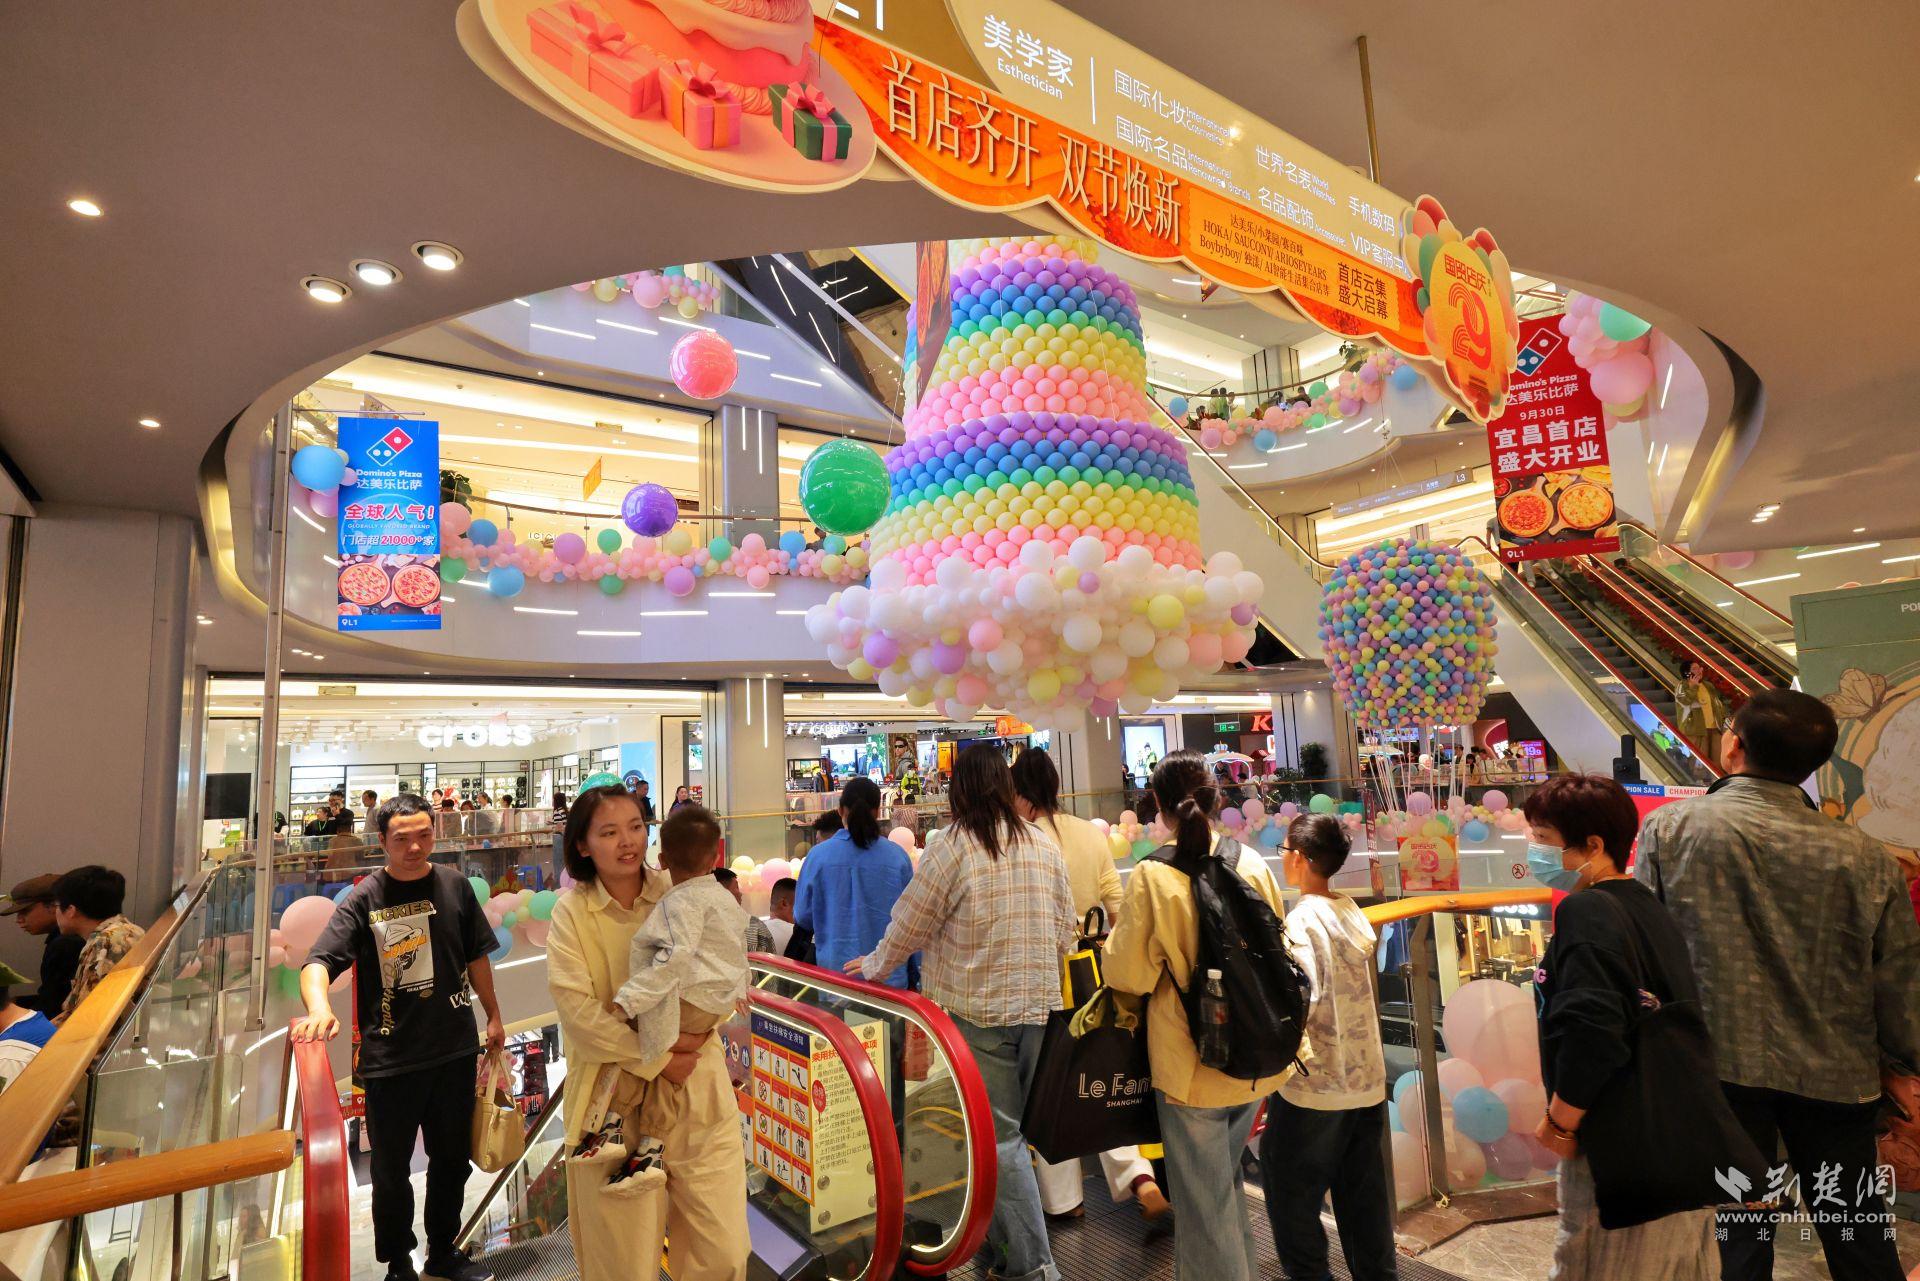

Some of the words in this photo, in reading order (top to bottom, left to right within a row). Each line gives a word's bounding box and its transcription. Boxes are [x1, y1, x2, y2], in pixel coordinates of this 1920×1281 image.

[983, 14, 1074, 87] 美学家
[997, 57, 1064, 100] Esthetician
[1114, 69, 1187, 128] 国际化妆
[882, 50, 1040, 188] 首店齐开
[1057, 132, 1182, 245] 双节焕新
[1116, 115, 1188, 172] 国际名品
[1255, 144, 1312, 193] 世界名表
[1258, 186, 1315, 230] 名品配饰
[1349, 195, 1395, 237] 手机数码
[1203, 219, 1234, 243] HOKA/
[1233, 233, 1274, 262] SAUCONY/
[1337, 261, 1387, 300] 首店云集
[1338, 284, 1388, 320] 盛大启幕
[1509, 379, 1548, 391] omino's
[1549, 374, 1578, 384] Pizza
[1519, 405, 1565, 420] 9月30日
[1494, 415, 1598, 450] 宜昌首店
[355, 469, 397, 477] Domino's
[398, 470, 422, 478] Pizza
[1497, 440, 1602, 474] 盛大开业
[356, 478, 423, 491] 达美乐比萨
[1513, 550, 1525, 558] L1
[1643, 786, 1660, 794] SALE
[1078, 1072, 1106, 1098] Le
[1106, 1097, 1143, 1108] SHANGHAI
